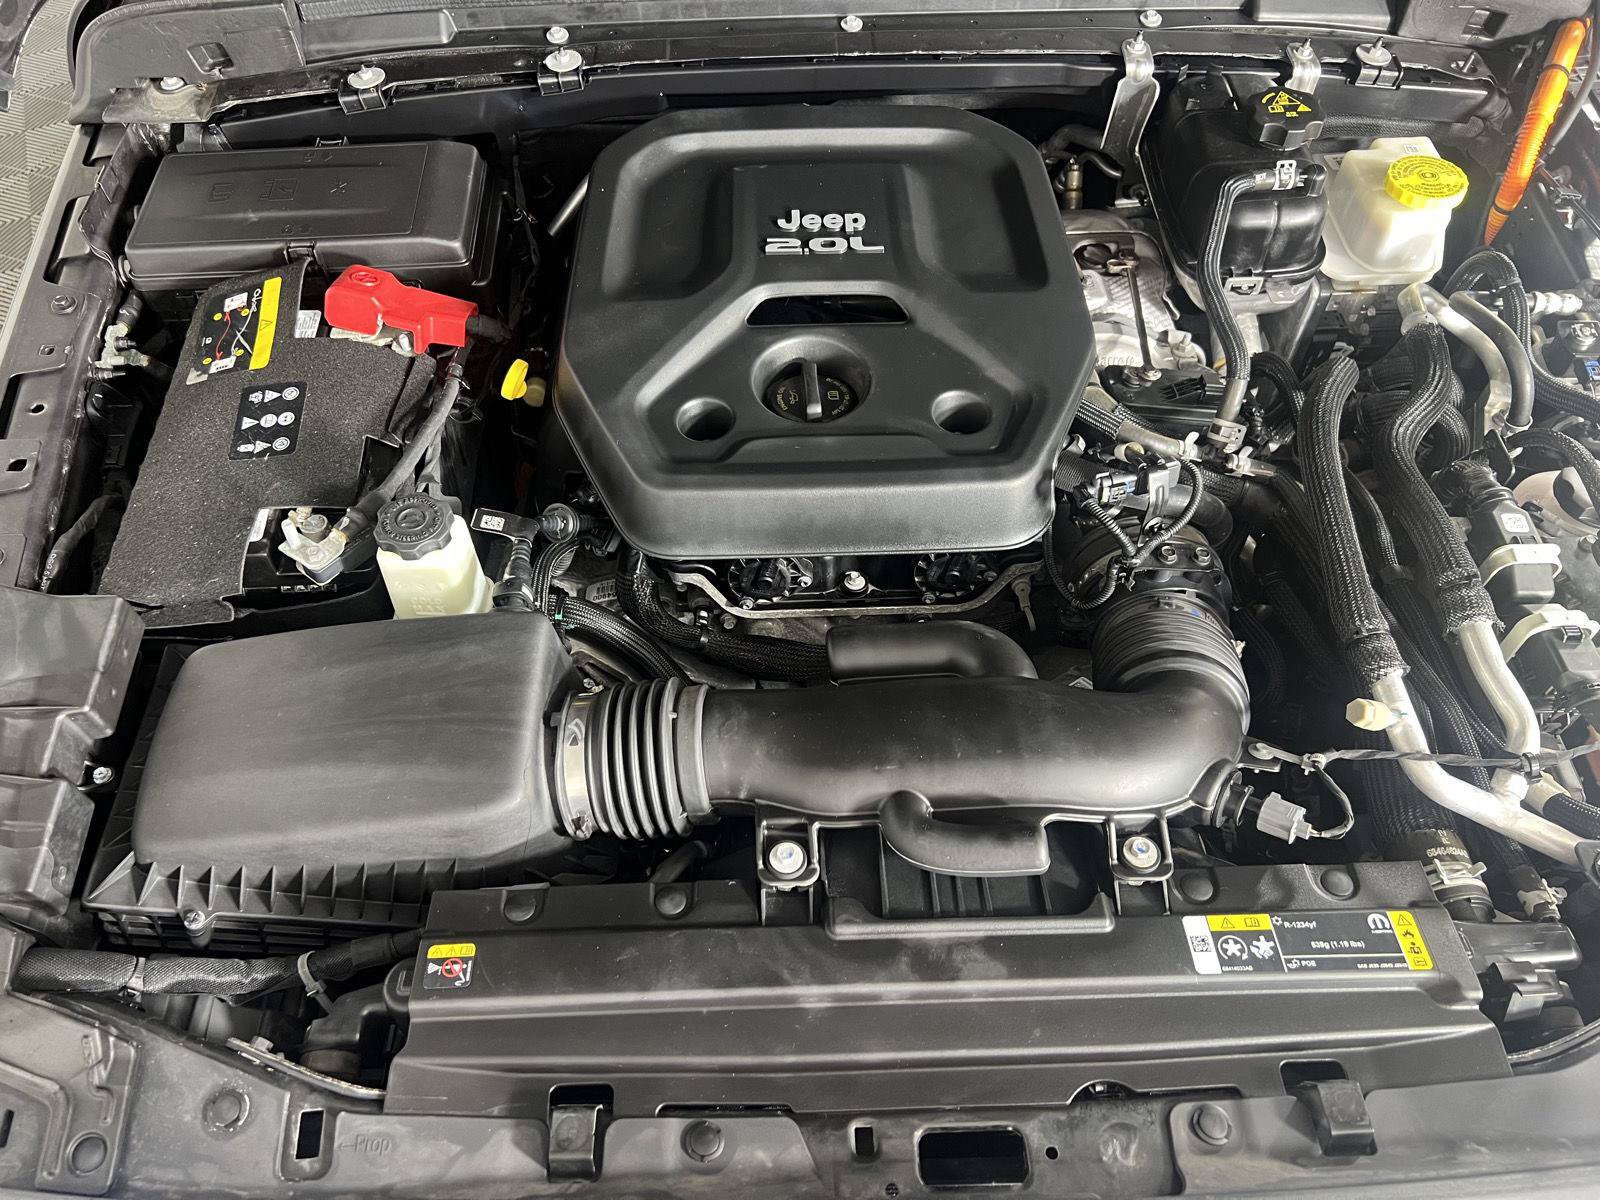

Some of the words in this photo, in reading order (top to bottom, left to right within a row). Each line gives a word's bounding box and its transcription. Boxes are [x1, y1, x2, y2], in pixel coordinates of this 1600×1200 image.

[777, 209, 866, 234] Jeep
[765, 236, 885, 255] 2.0L
[354, 1134, 392, 1156] Prop
